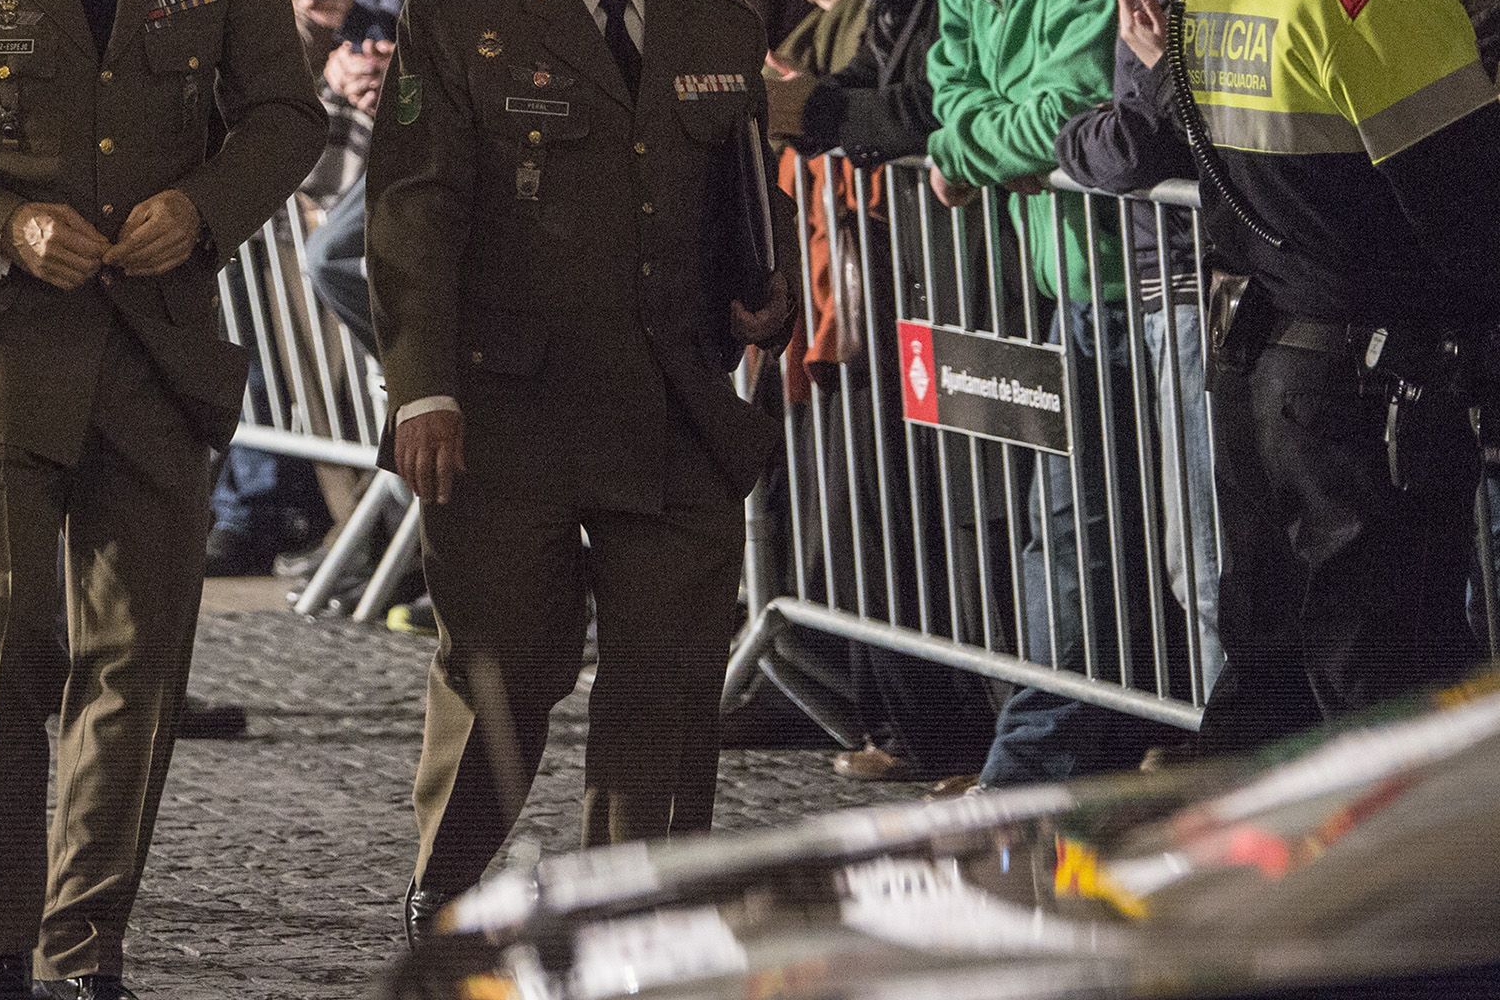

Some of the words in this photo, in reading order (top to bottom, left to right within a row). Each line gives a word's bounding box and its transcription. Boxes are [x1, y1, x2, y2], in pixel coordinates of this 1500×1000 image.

[1182, 17, 1268, 63] POLICIA
[941, 365, 998, 400] Ajuntament
[999, 377, 1012, 403] de
[1011, 379, 1061, 413] Barcelona
